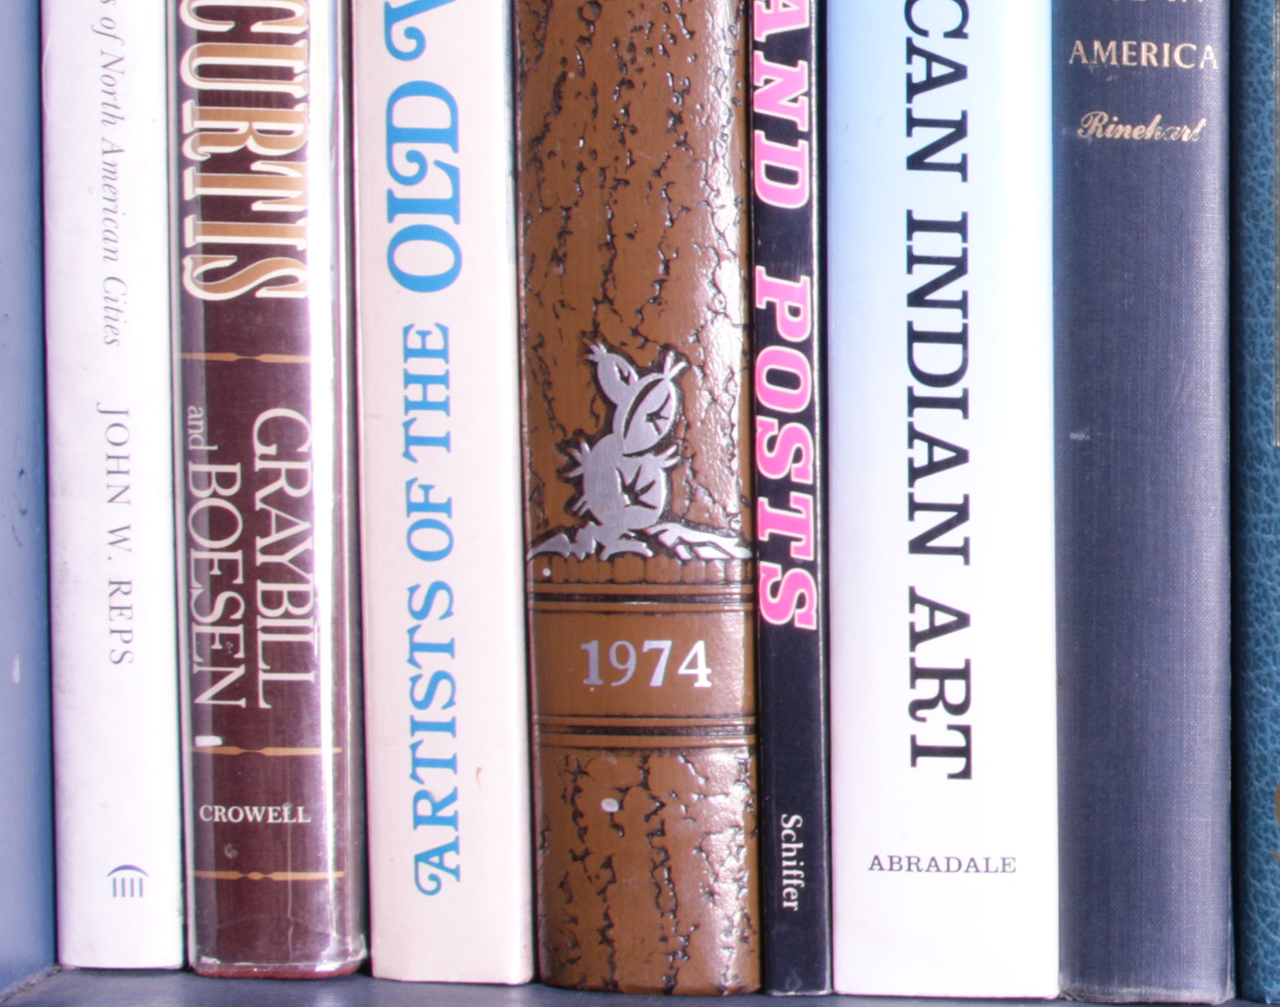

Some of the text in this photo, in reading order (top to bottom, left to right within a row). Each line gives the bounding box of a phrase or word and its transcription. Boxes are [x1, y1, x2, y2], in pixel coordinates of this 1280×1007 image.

[91, 6, 117, 36] of
[1069, 40, 1219, 69] AMERICA
[98, 43, 125, 125] North
[1077, 111, 1206, 143] Rinehart
[100, 134, 127, 262] American
[385, 80, 462, 293] OLD
[102, 275, 128, 347] Cities
[403, 322, 450, 463] THE
[906, 208, 970, 566] INDIAN
[755, 266, 817, 630] POSTS
[97, 401, 134, 666] JOHN W. REPS
[187, 404, 245, 709] and BOESEN
[253, 407, 315, 709] GRAYBILL
[405, 477, 453, 561] OF
[581, 640, 712, 688] 1974
[907, 586, 972, 780] ART
[409, 579, 460, 897] ARTISTS
[199, 803, 311, 823] CROWELL
[781, 813, 803, 910] Schiffer
[868, 855, 1016, 874] ABRADALE
